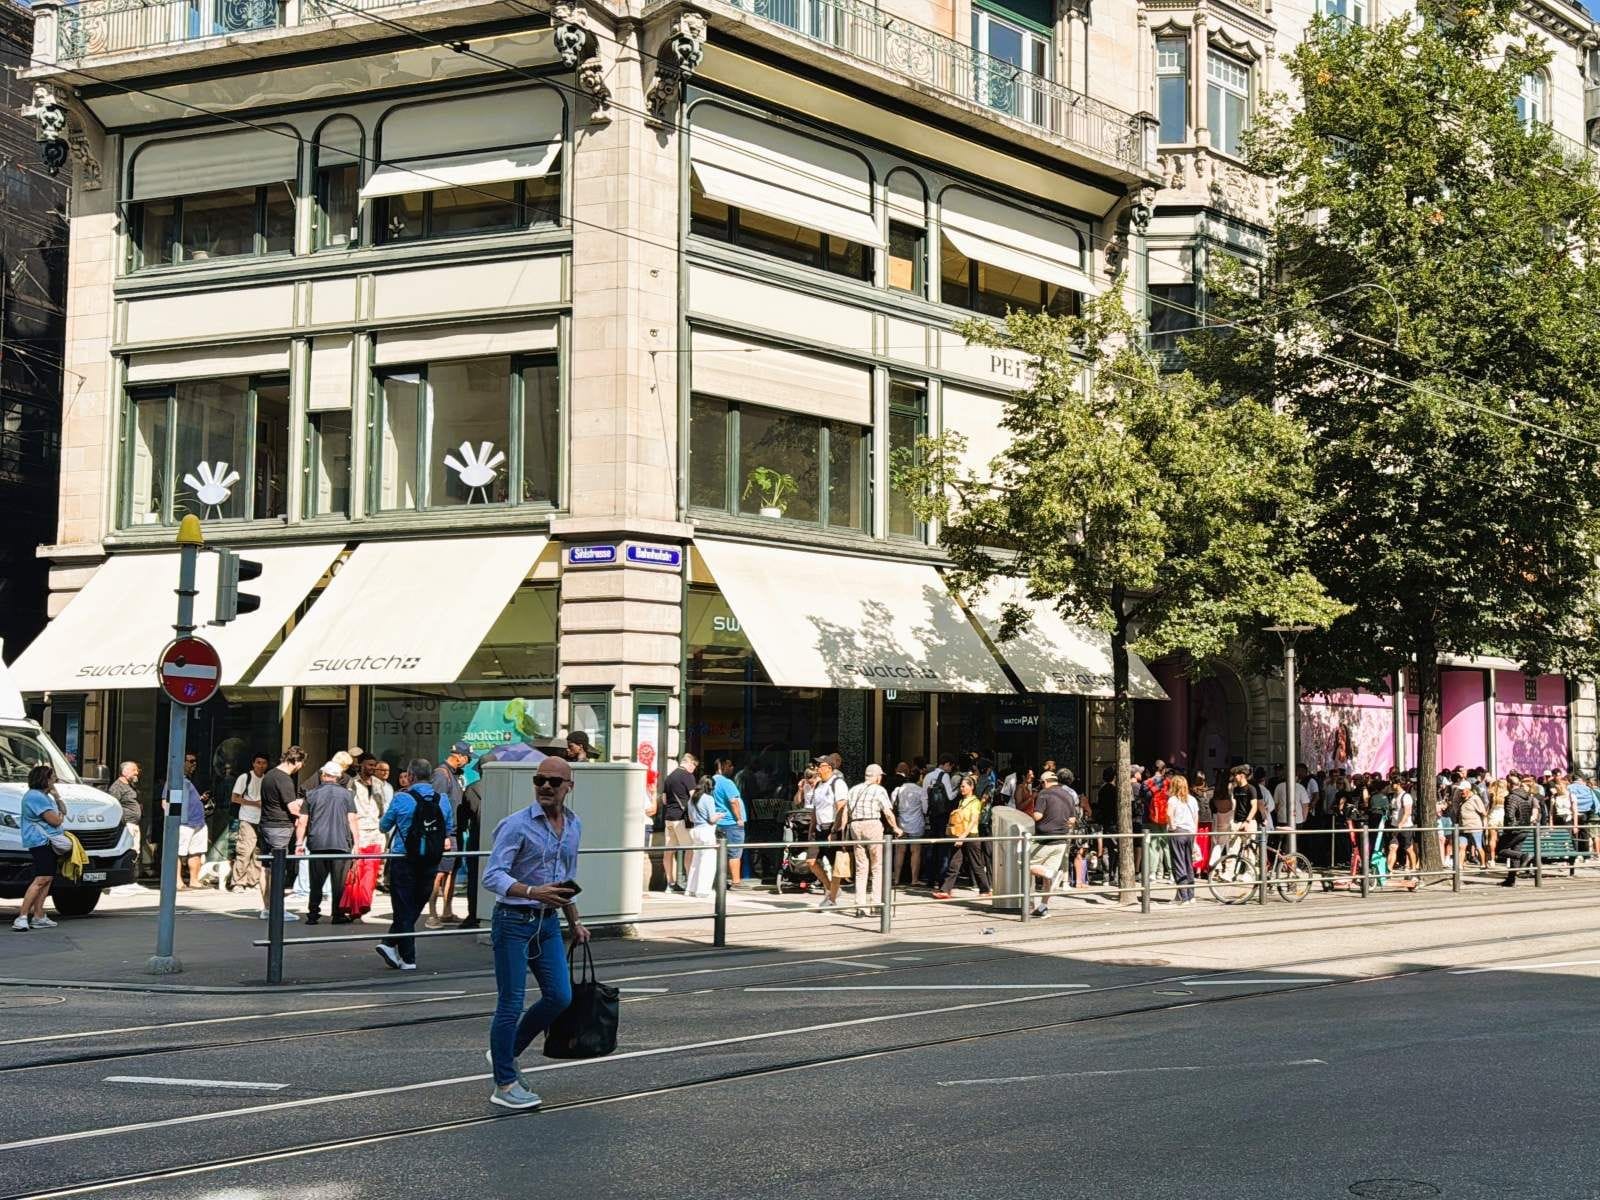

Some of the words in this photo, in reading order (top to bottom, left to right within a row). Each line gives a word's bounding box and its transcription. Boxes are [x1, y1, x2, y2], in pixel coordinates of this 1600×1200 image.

[574, 547, 612, 560] Sihlstrasse
[308, 655, 402, 671] swatch
[843, 664, 923, 679] swatch
[461, 729, 504, 741] swatch
[65, 814, 105, 823] VECO
